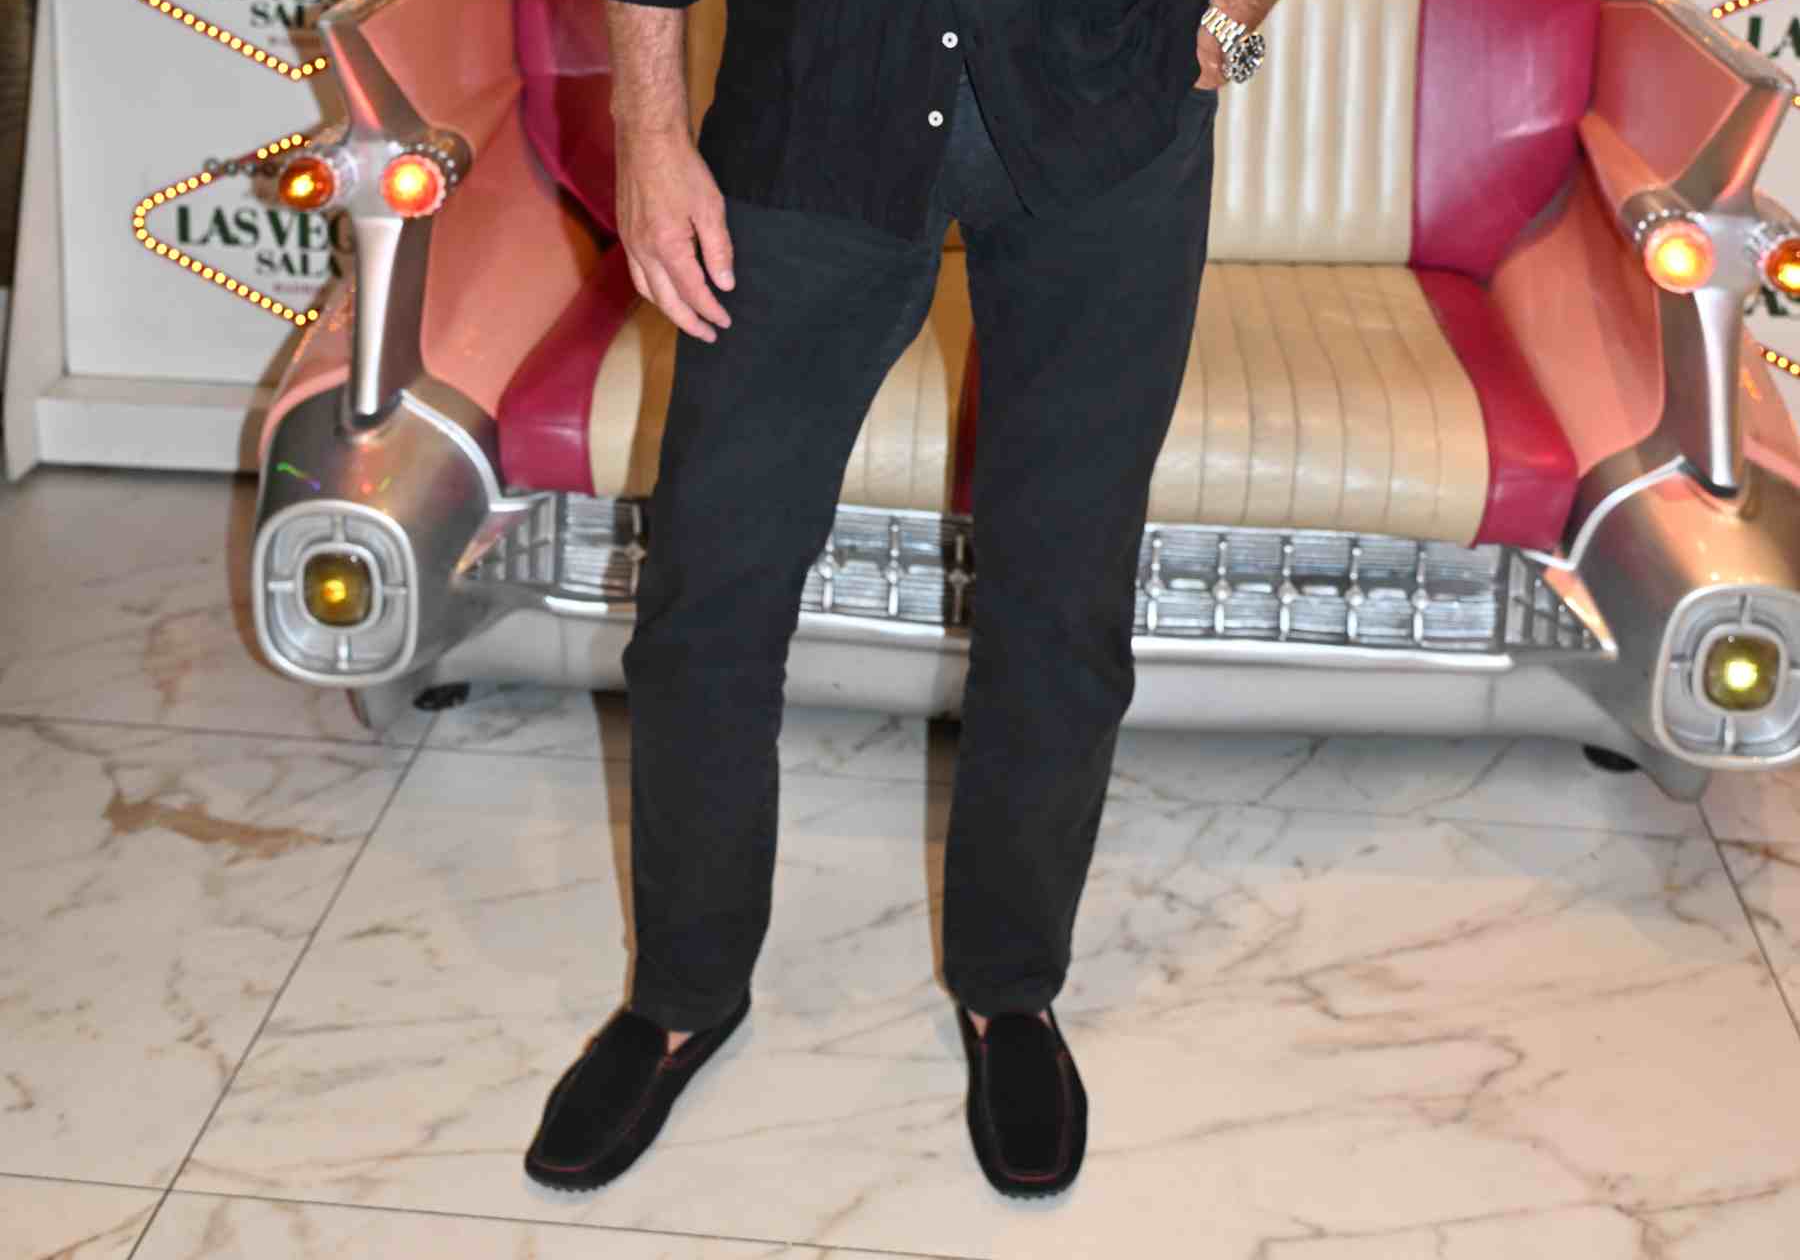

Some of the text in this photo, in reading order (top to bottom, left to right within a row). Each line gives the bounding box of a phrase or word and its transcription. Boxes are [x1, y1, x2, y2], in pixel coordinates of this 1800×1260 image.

[251, 3, 317, 29] SAL
[1749, 16, 1800, 59] LA
[177, 205, 354, 253] LAS VEG
[257, 251, 342, 278] SALA
